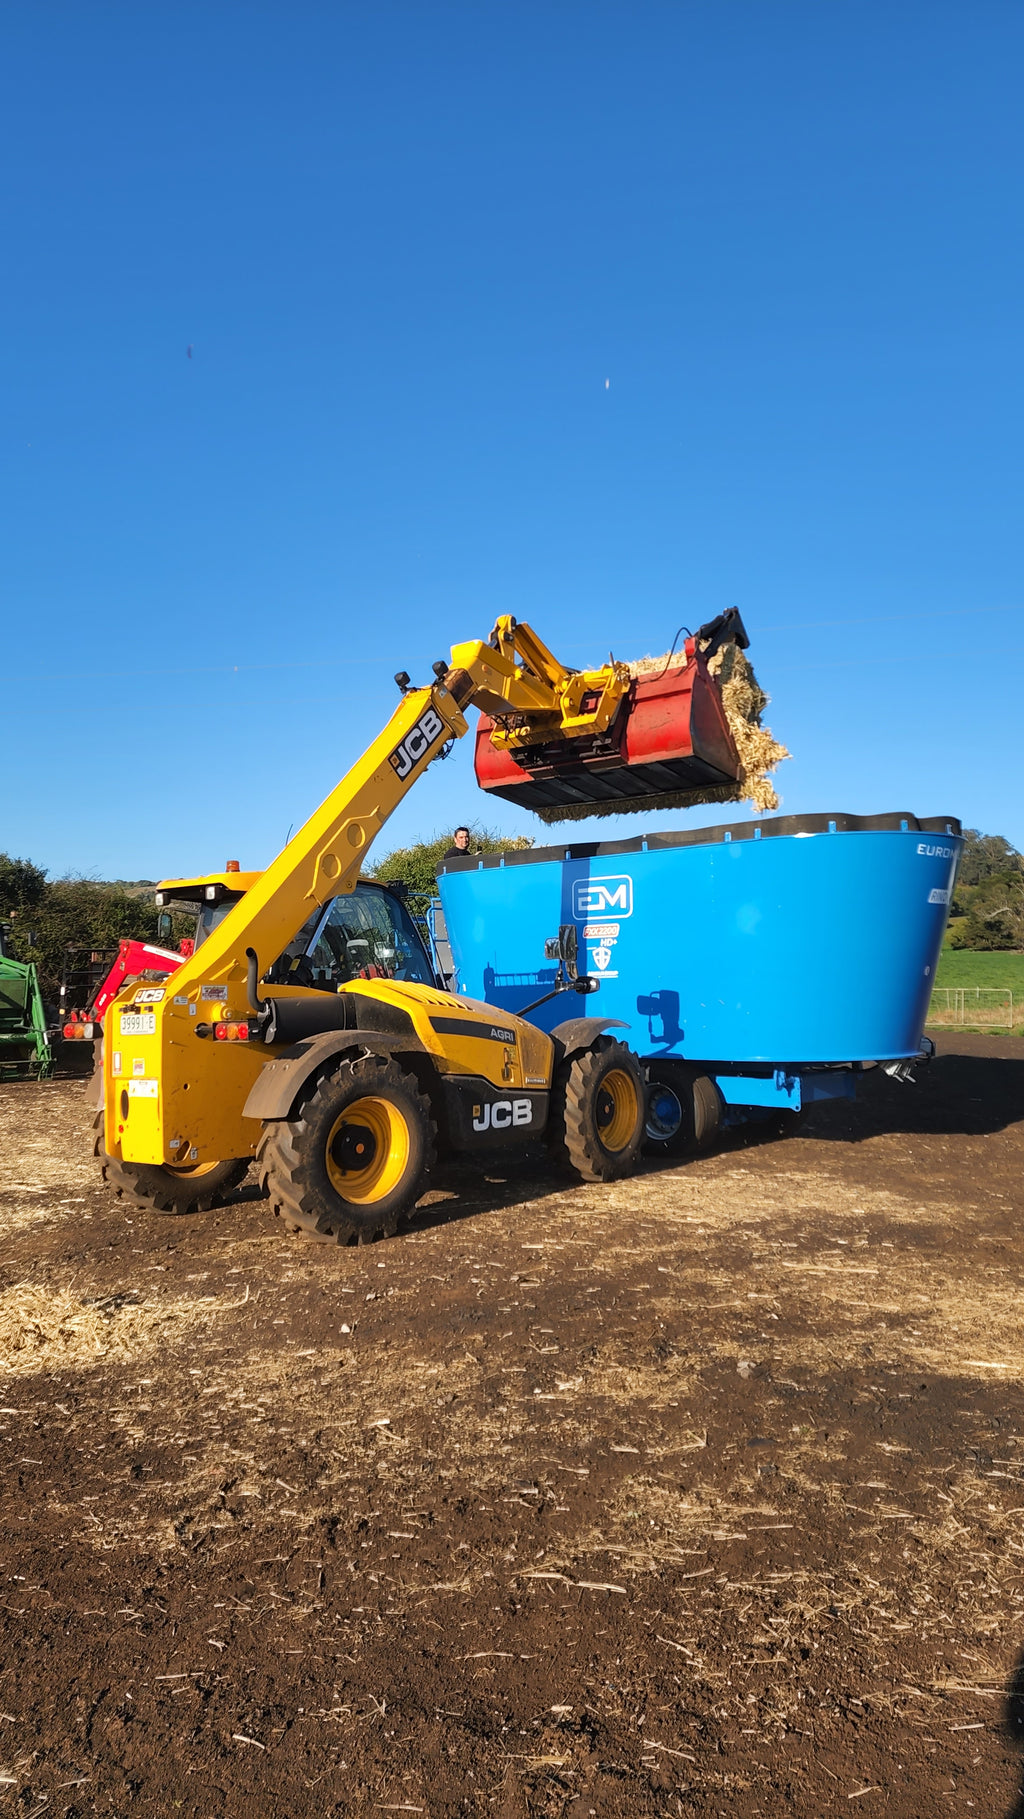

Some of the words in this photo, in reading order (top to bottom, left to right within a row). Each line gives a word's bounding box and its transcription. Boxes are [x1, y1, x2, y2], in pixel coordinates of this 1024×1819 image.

[396, 709, 443, 777] JCB
[134, 990, 165, 1003] JCB
[490, 1028, 515, 1042] AGRI
[473, 1098, 533, 1132] JCB
